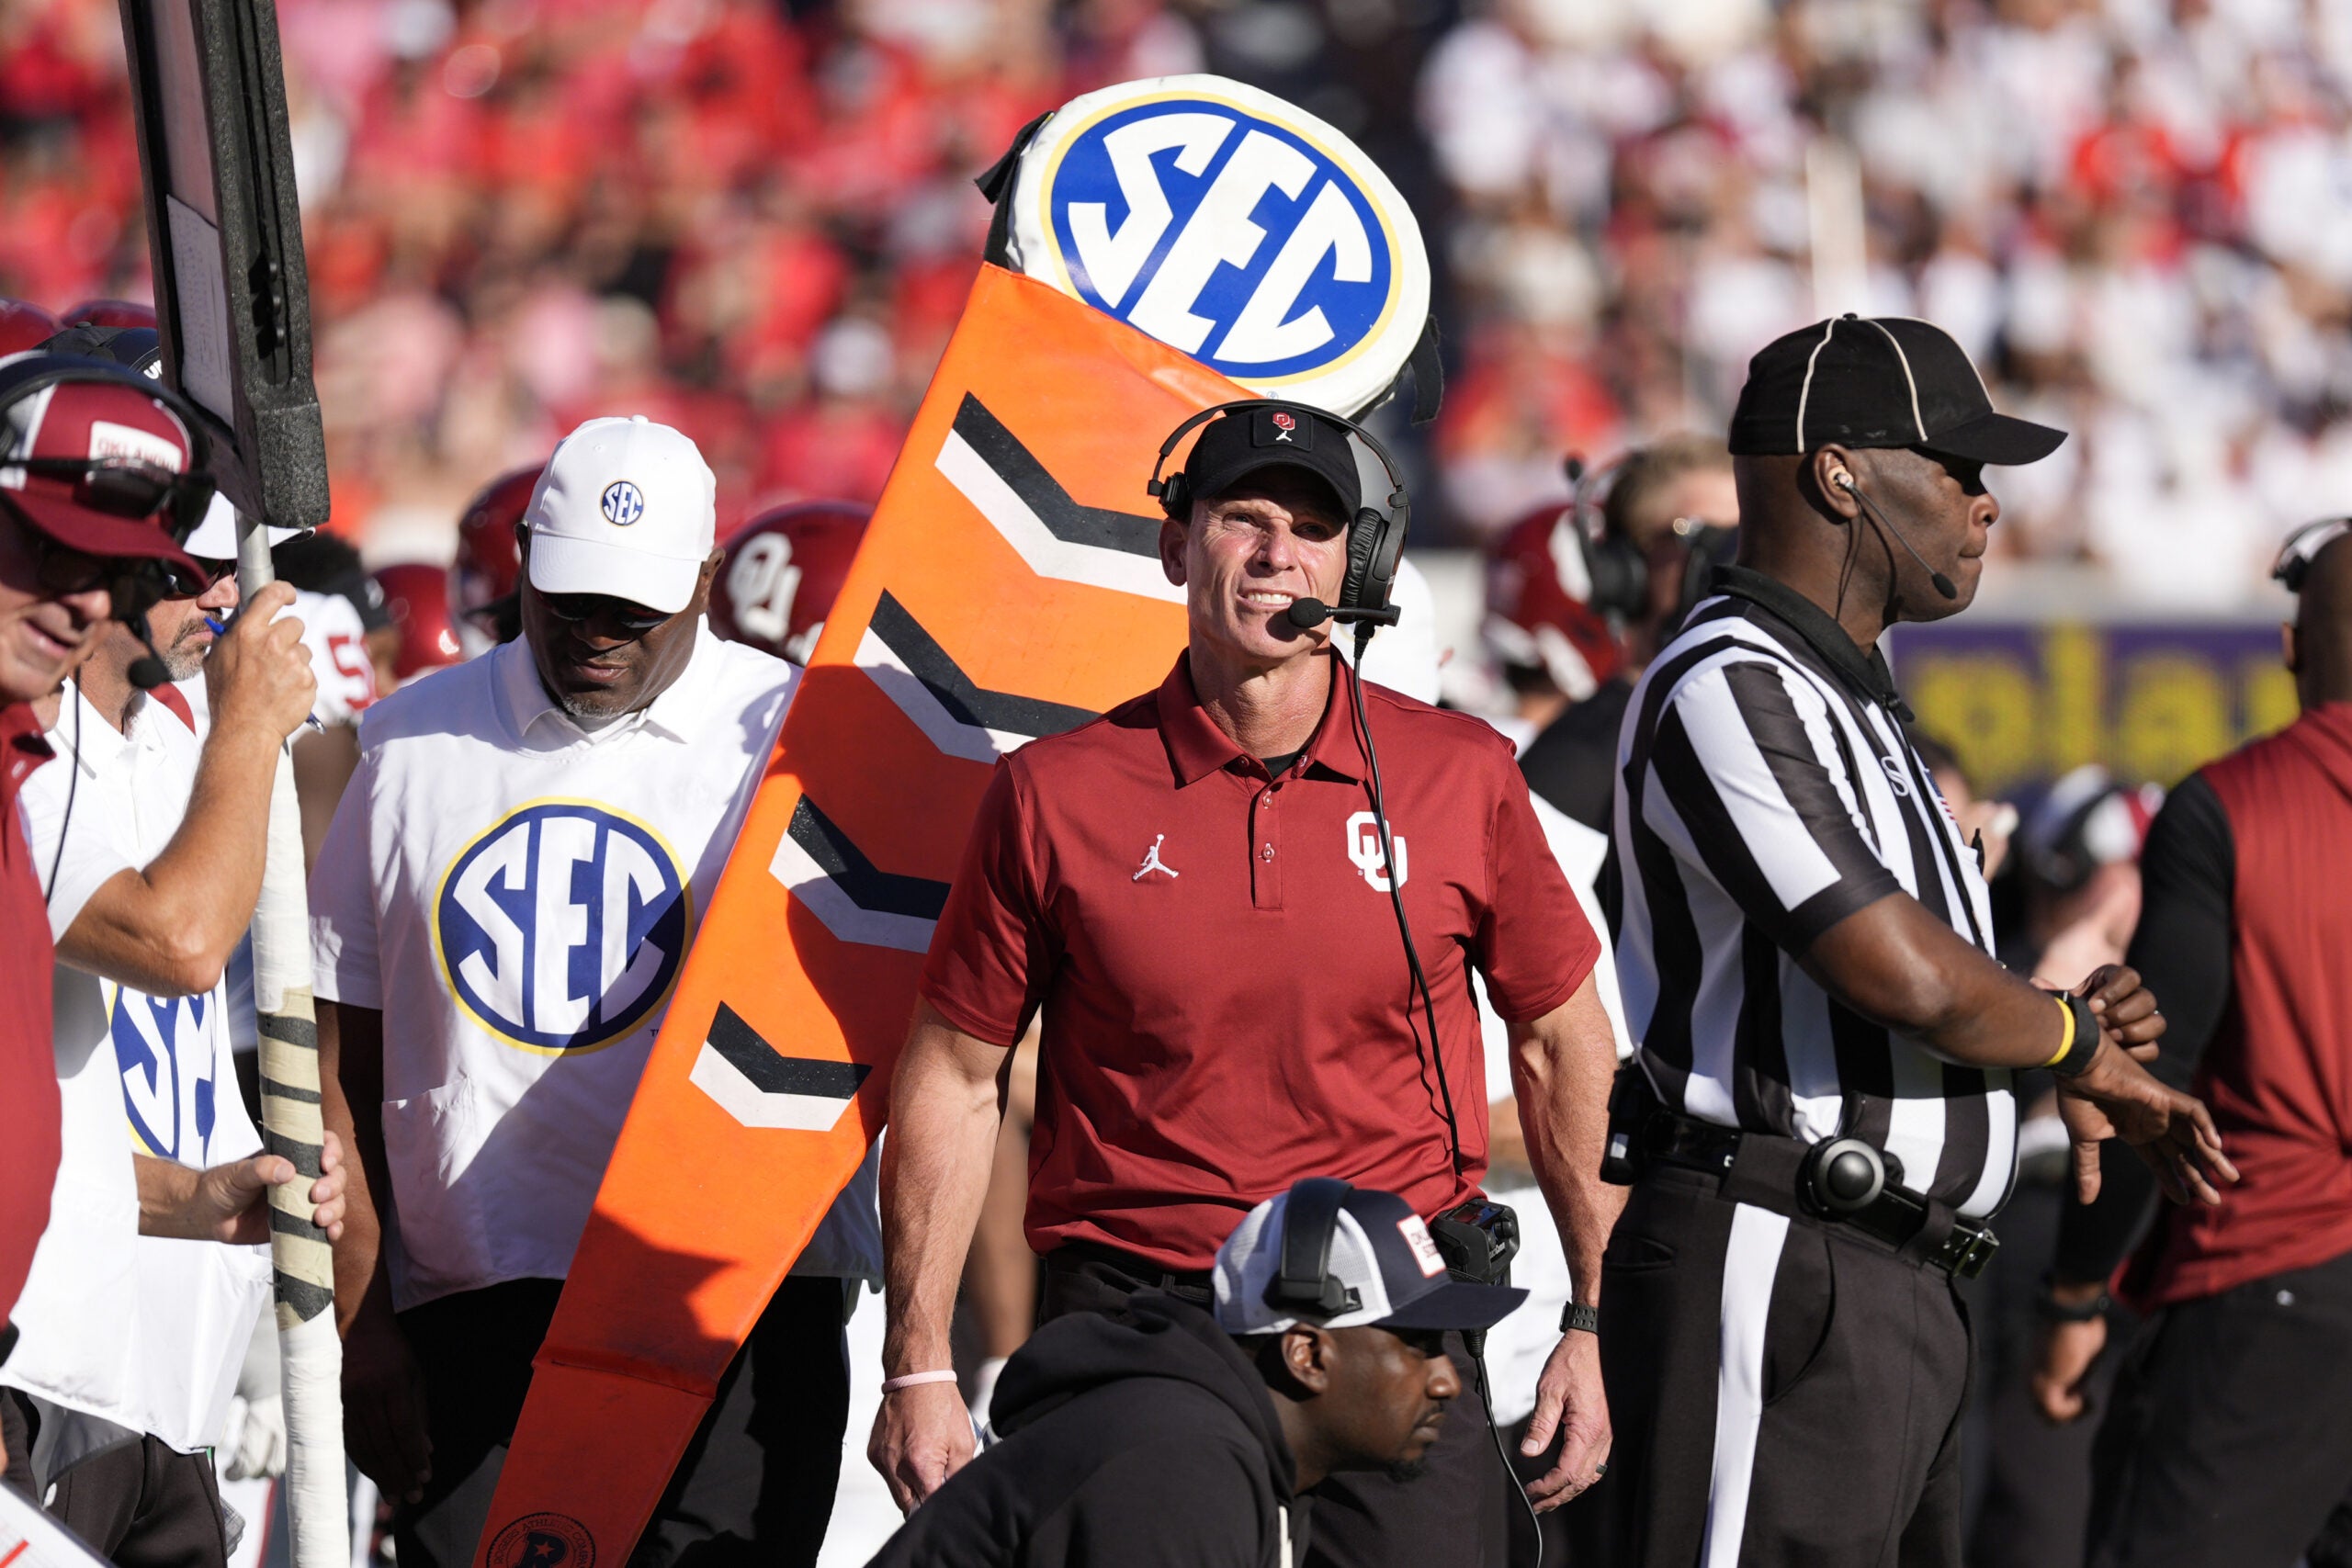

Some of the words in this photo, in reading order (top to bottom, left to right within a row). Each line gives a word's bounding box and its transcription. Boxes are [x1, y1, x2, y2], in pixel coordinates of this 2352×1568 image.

[1069, 112, 1372, 364] SEC
[1272, 412, 1295, 430] OU
[603, 482, 642, 525] SEC
[727, 531, 802, 641] OU
[1881, 756, 1909, 796] S
[1346, 812, 1408, 892] OU
[453, 817, 666, 1034] SEC
[494, 1529, 521, 1565] ROGERS
[523, 1517, 574, 1533] ATHLETIC
